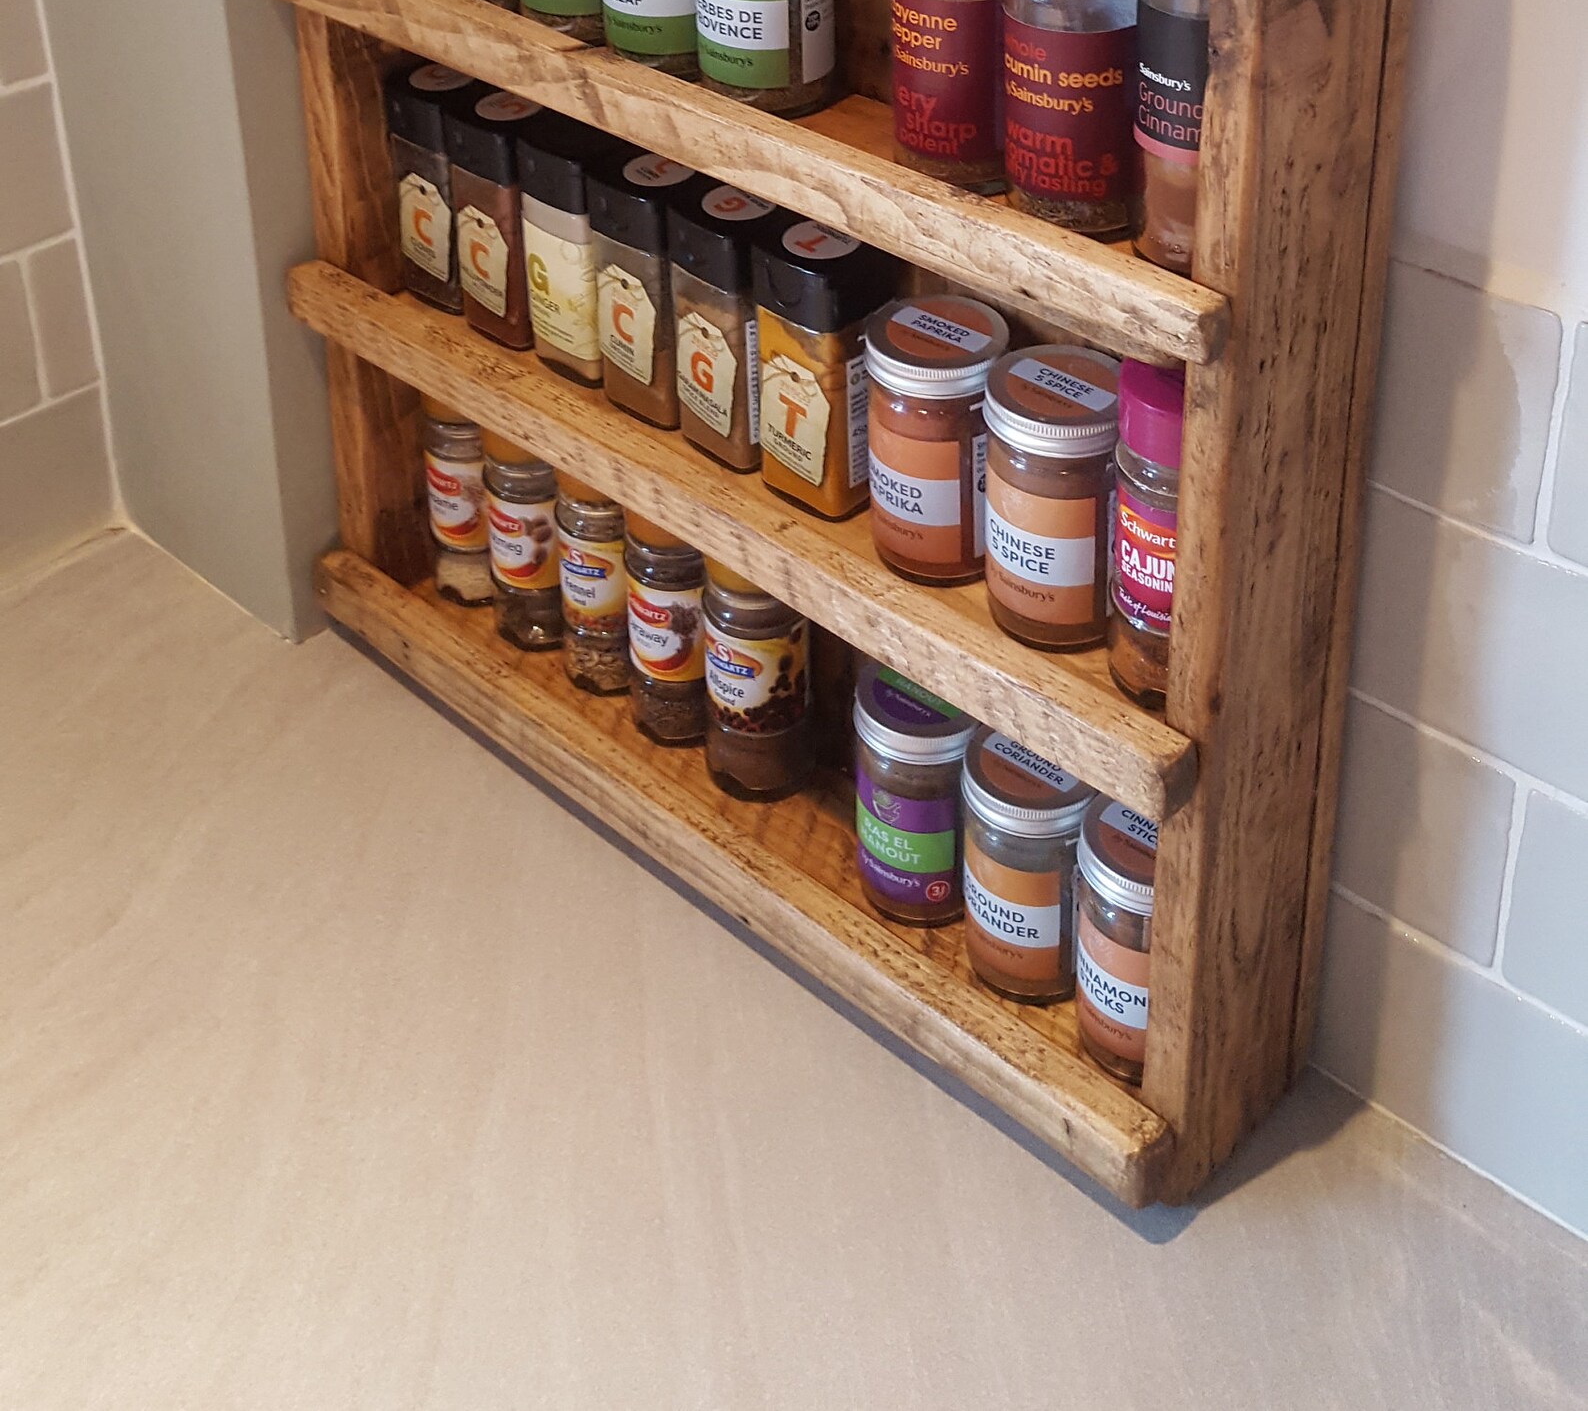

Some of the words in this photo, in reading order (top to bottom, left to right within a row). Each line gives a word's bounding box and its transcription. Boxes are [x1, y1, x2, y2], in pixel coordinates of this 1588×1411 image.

[697, 13, 764, 41] ROVENCE
[739, 9, 764, 25] DE
[895, 44, 970, 79] Sainsbury's
[1004, 52, 1052, 86] cumin
[1058, 66, 1124, 89] seeds
[1138, 62, 1192, 92] Sainsbury's
[896, 84, 938, 120] ery
[1010, 80, 1095, 116] Sainsbury's
[906, 110, 977, 145] sharp
[1007, 118, 1074, 155] warm
[412, 206, 433, 248] C
[469, 239, 491, 280] C
[527, 251, 550, 297] G
[611, 301, 635, 345] C
[910, 319, 963, 345] PAPRIKA
[917, 312, 971, 338] SMOKED
[690, 350, 715, 394] G
[1032, 374, 1045, 384] 5
[1044, 377, 1084, 400] SPICE
[1039, 367, 1095, 396] CHINESE
[778, 391, 808, 440] T
[767, 421, 813, 462] TURMERIC
[868, 458, 923, 501] MOKED
[868, 478, 924, 517] APRIKA
[989, 517, 1056, 562] CHINESE
[1120, 510, 1177, 551] Schwart
[991, 535, 999, 550] 5
[1000, 542, 1050, 576] SPICE
[998, 571, 1056, 603] Sainsbury's
[1120, 559, 1173, 594] SEASONIN
[717, 645, 731, 662] S
[708, 669, 746, 699] Allspice
[994, 741, 1065, 787] CORIANDER
[862, 829, 921, 866] HANOUT
[863, 816, 890, 843] RAS
[893, 835, 914, 852] EL
[1126, 822, 1159, 847] STIC
[869, 858, 921, 889] Sainsbury's
[1079, 967, 1126, 1016] STICKS
